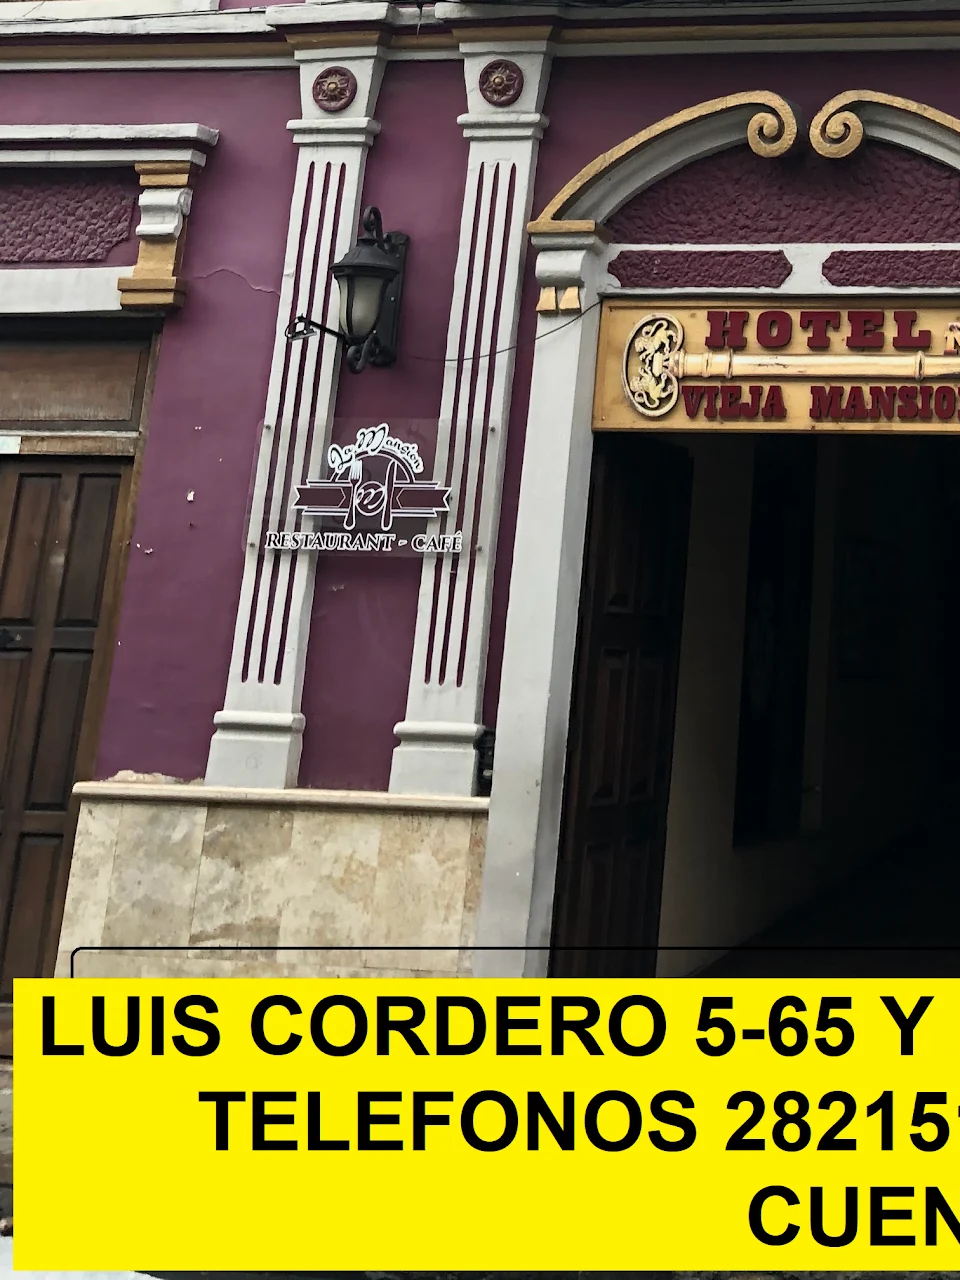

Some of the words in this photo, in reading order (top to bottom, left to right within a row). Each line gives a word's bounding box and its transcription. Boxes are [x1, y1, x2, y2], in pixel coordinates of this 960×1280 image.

[705, 310, 931, 350] HOTEL
[681, 385, 787, 420] VIEJA
[329, 445, 354, 472] La
[357, 424, 423, 472] Mansion
[265, 531, 396, 552] RESTAURANT
[411, 530, 463, 552] CAFÉ
